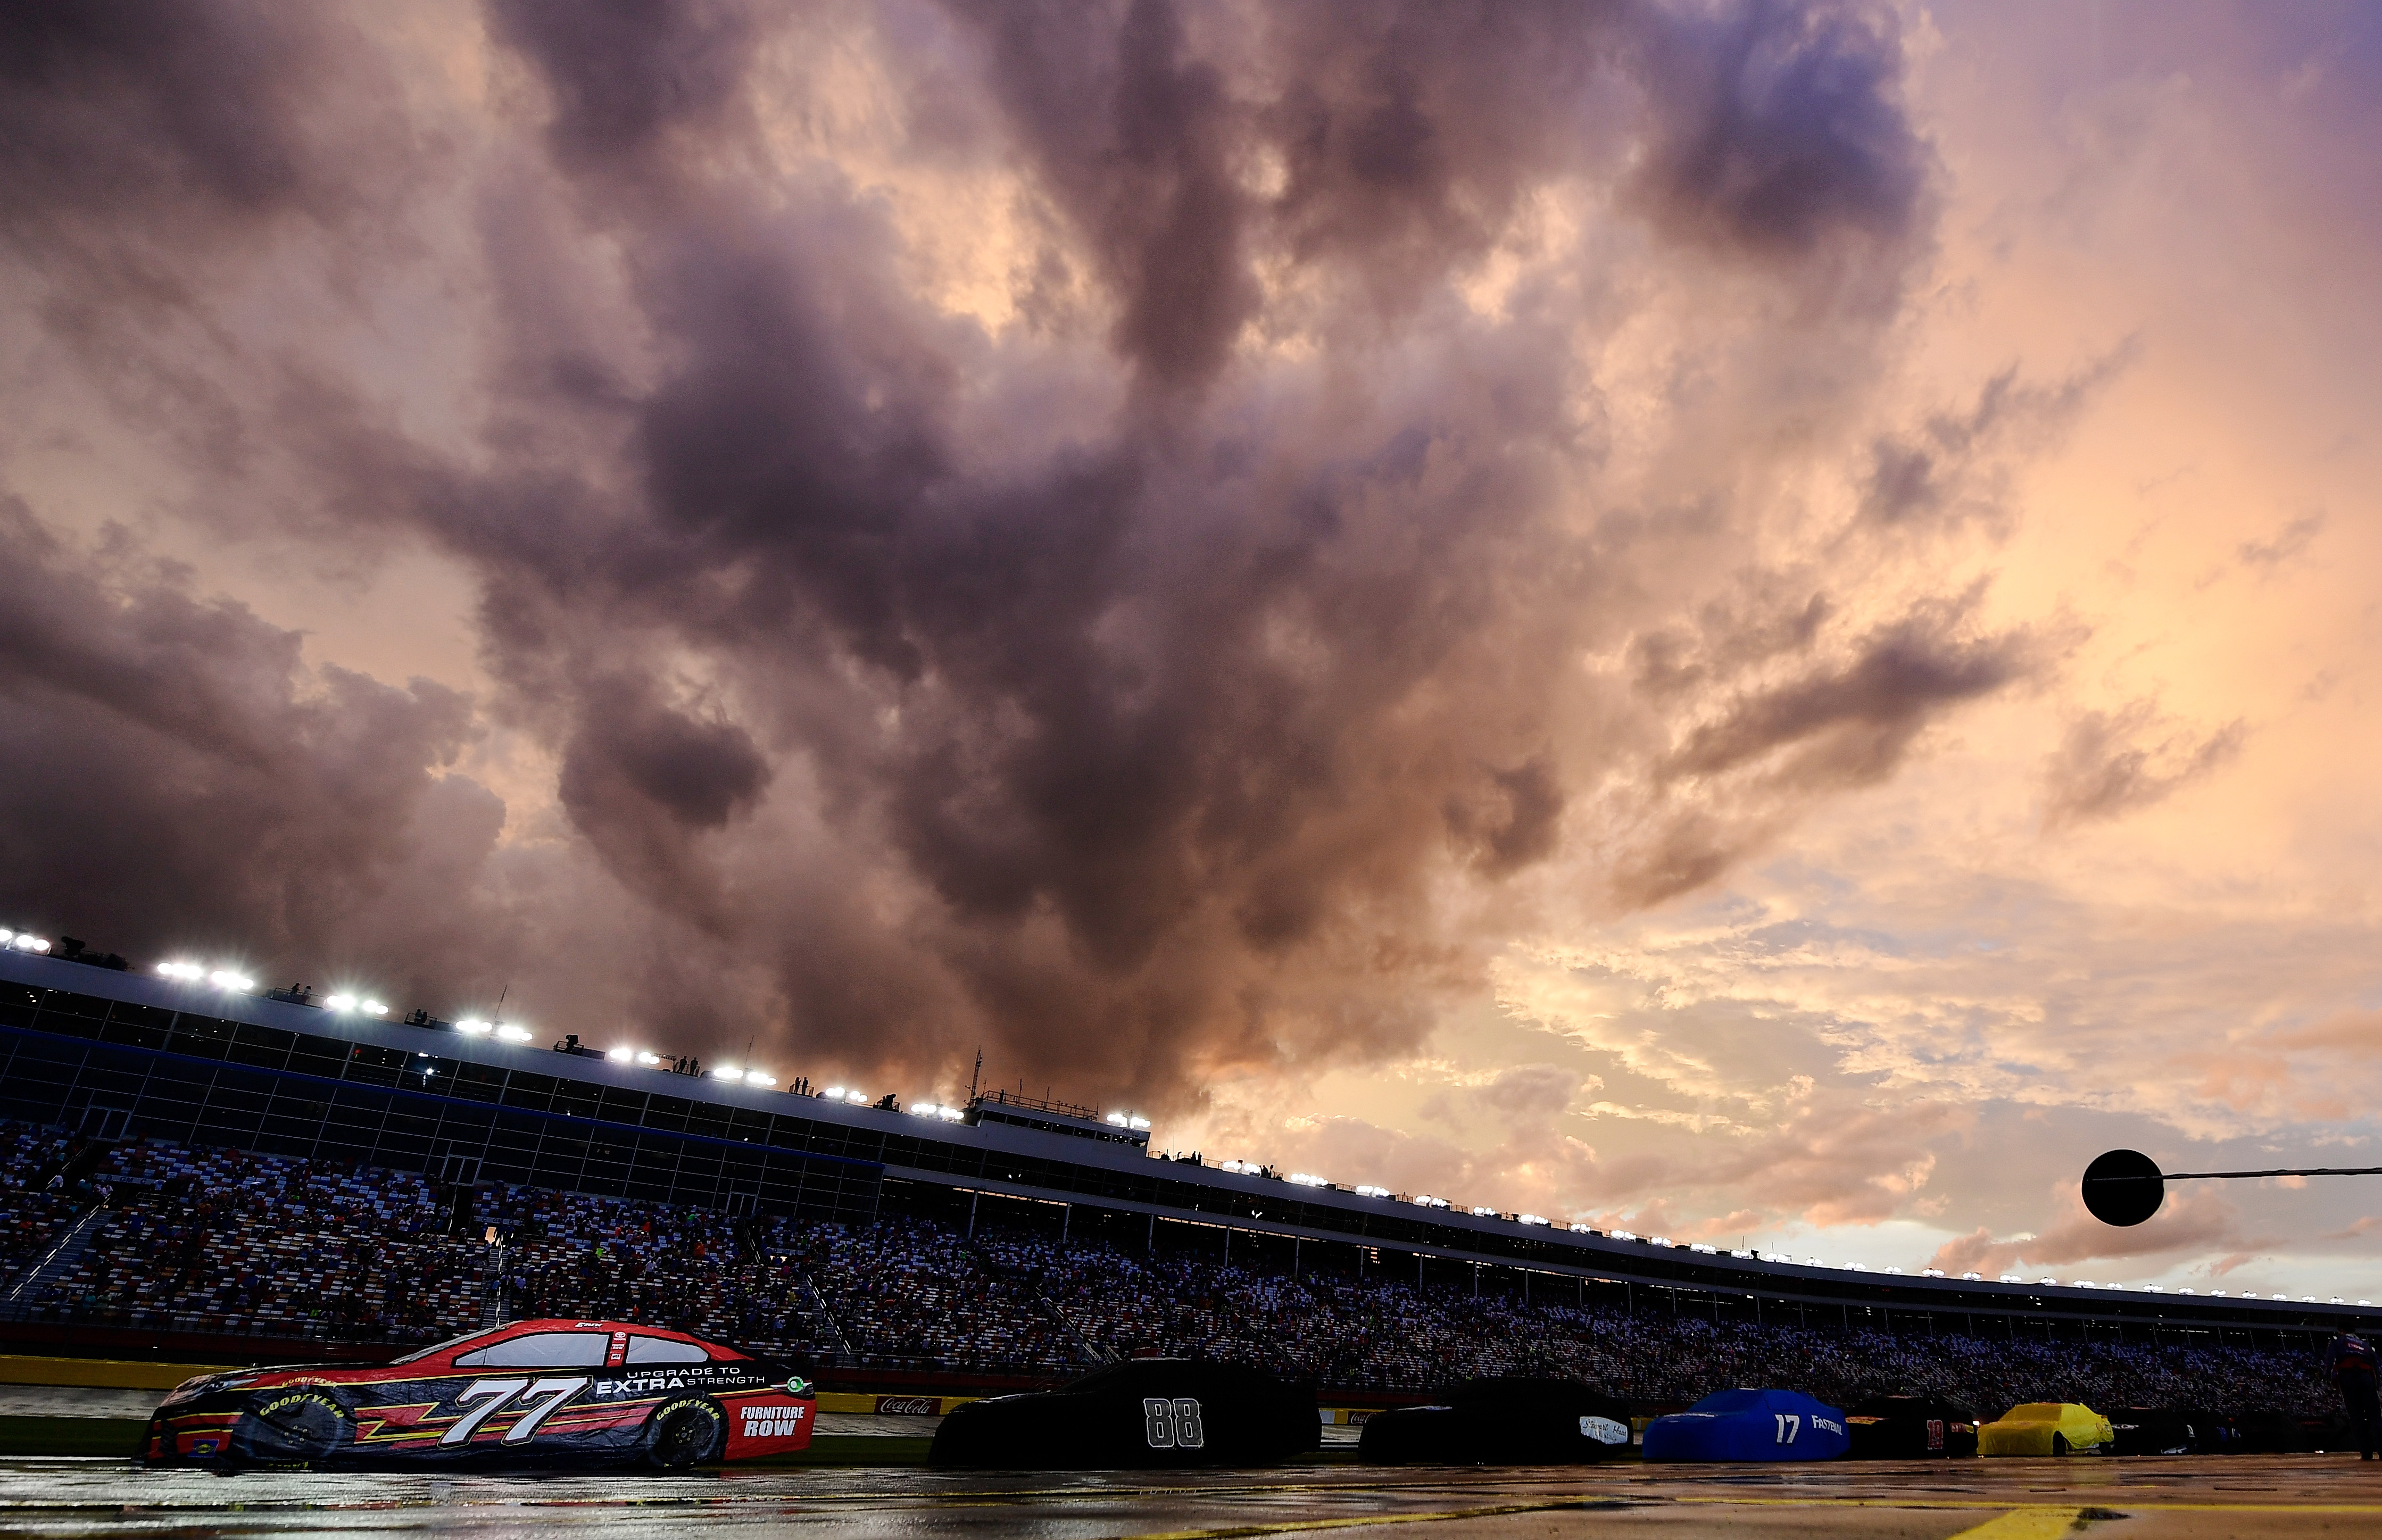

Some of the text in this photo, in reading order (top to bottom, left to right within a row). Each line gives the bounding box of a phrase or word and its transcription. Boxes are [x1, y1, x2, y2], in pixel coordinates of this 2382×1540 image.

[627, 1367, 713, 1378] UPGRADE
[596, 1376, 765, 1395] EXTRA STRENGTH
[259, 1393, 345, 1419] GOODYEAR
[437, 1375, 593, 1449] 77
[656, 1399, 721, 1421] GOODYEAR
[740, 1406, 805, 1419] FURNITURE
[880, 1397, 934, 1414] Coca-Cola
[744, 1420, 796, 1437] ROW
[1143, 1398, 1204, 1447] 88
[1775, 1414, 1799, 1443] 17
